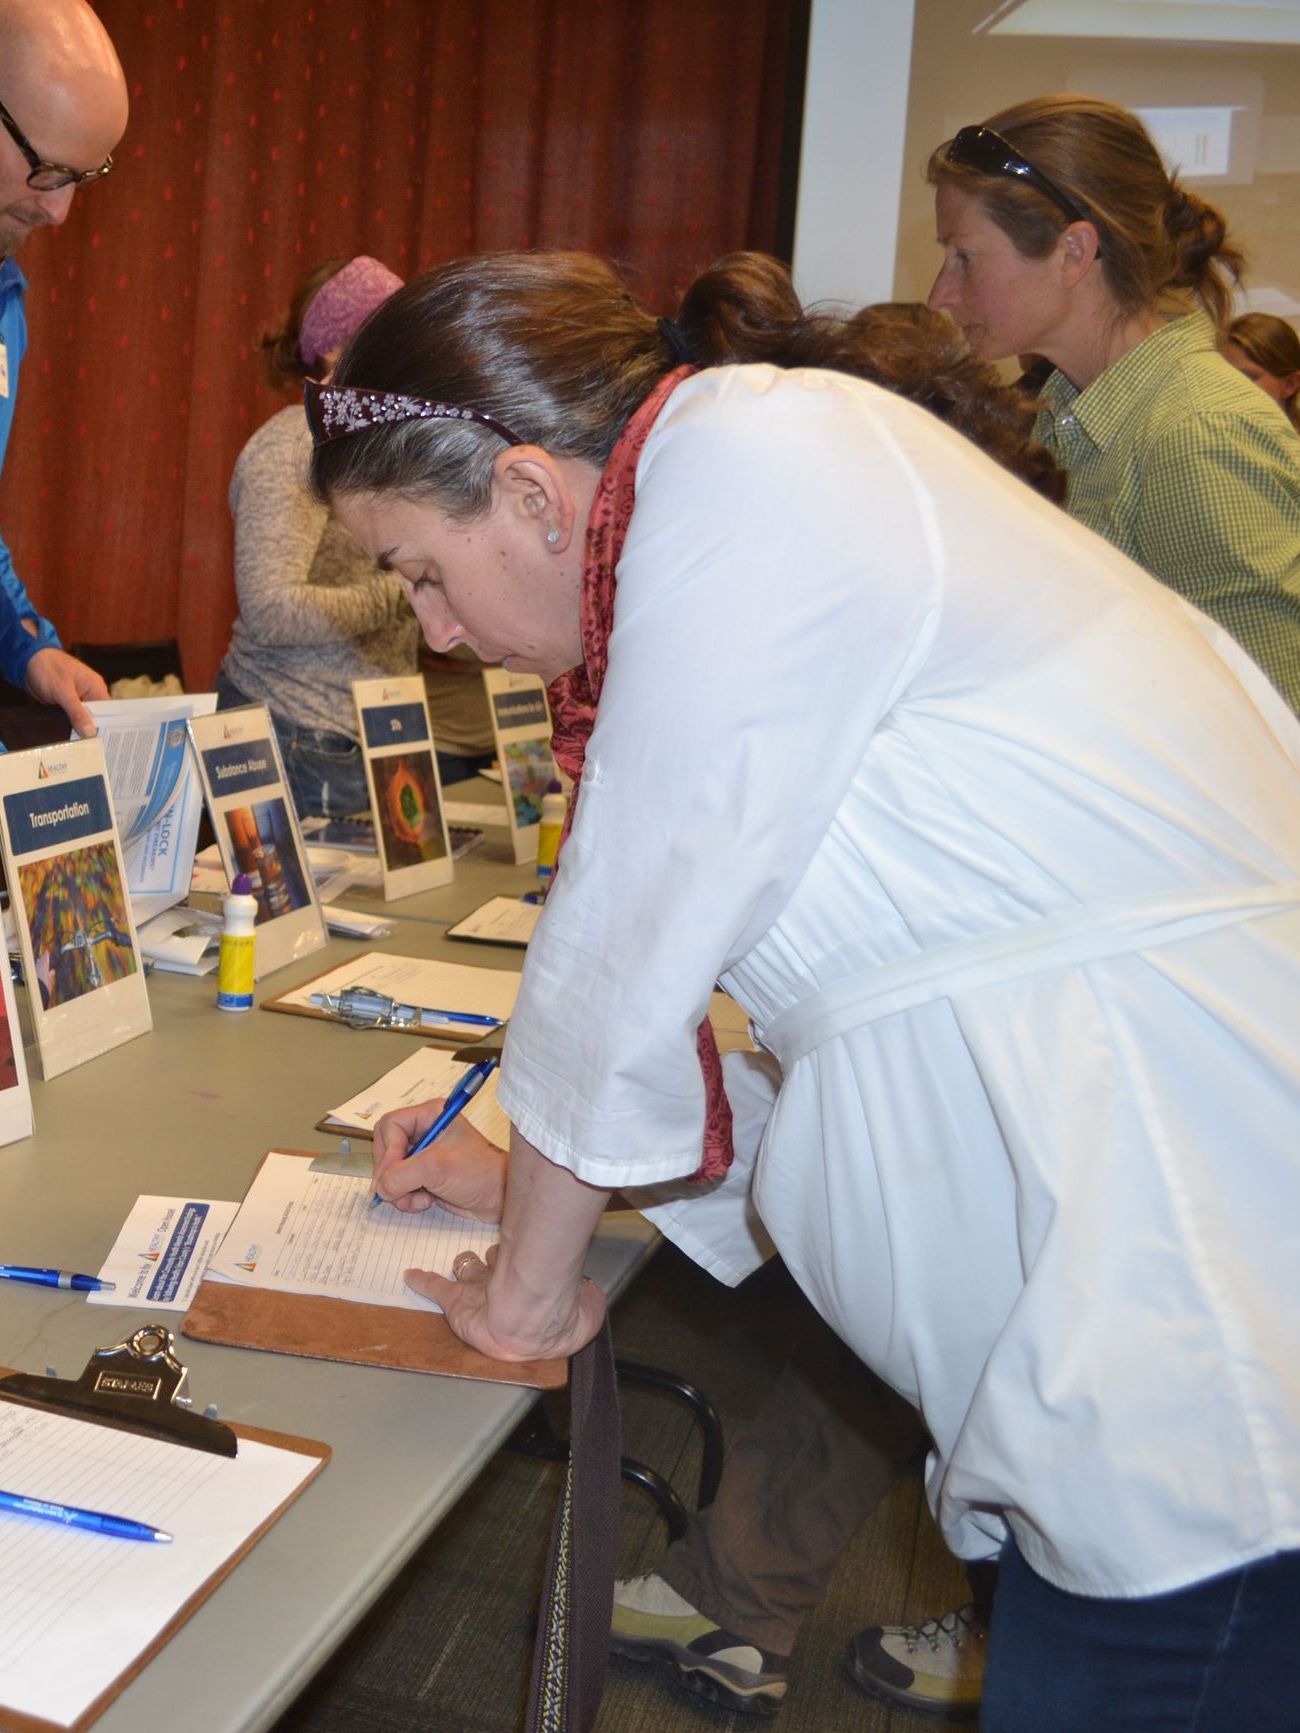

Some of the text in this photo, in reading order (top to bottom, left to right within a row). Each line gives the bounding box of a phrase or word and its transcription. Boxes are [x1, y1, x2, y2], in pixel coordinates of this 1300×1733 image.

[215, 759, 268, 779] Substance Abuse
[29, 802, 90, 829] Transportation
